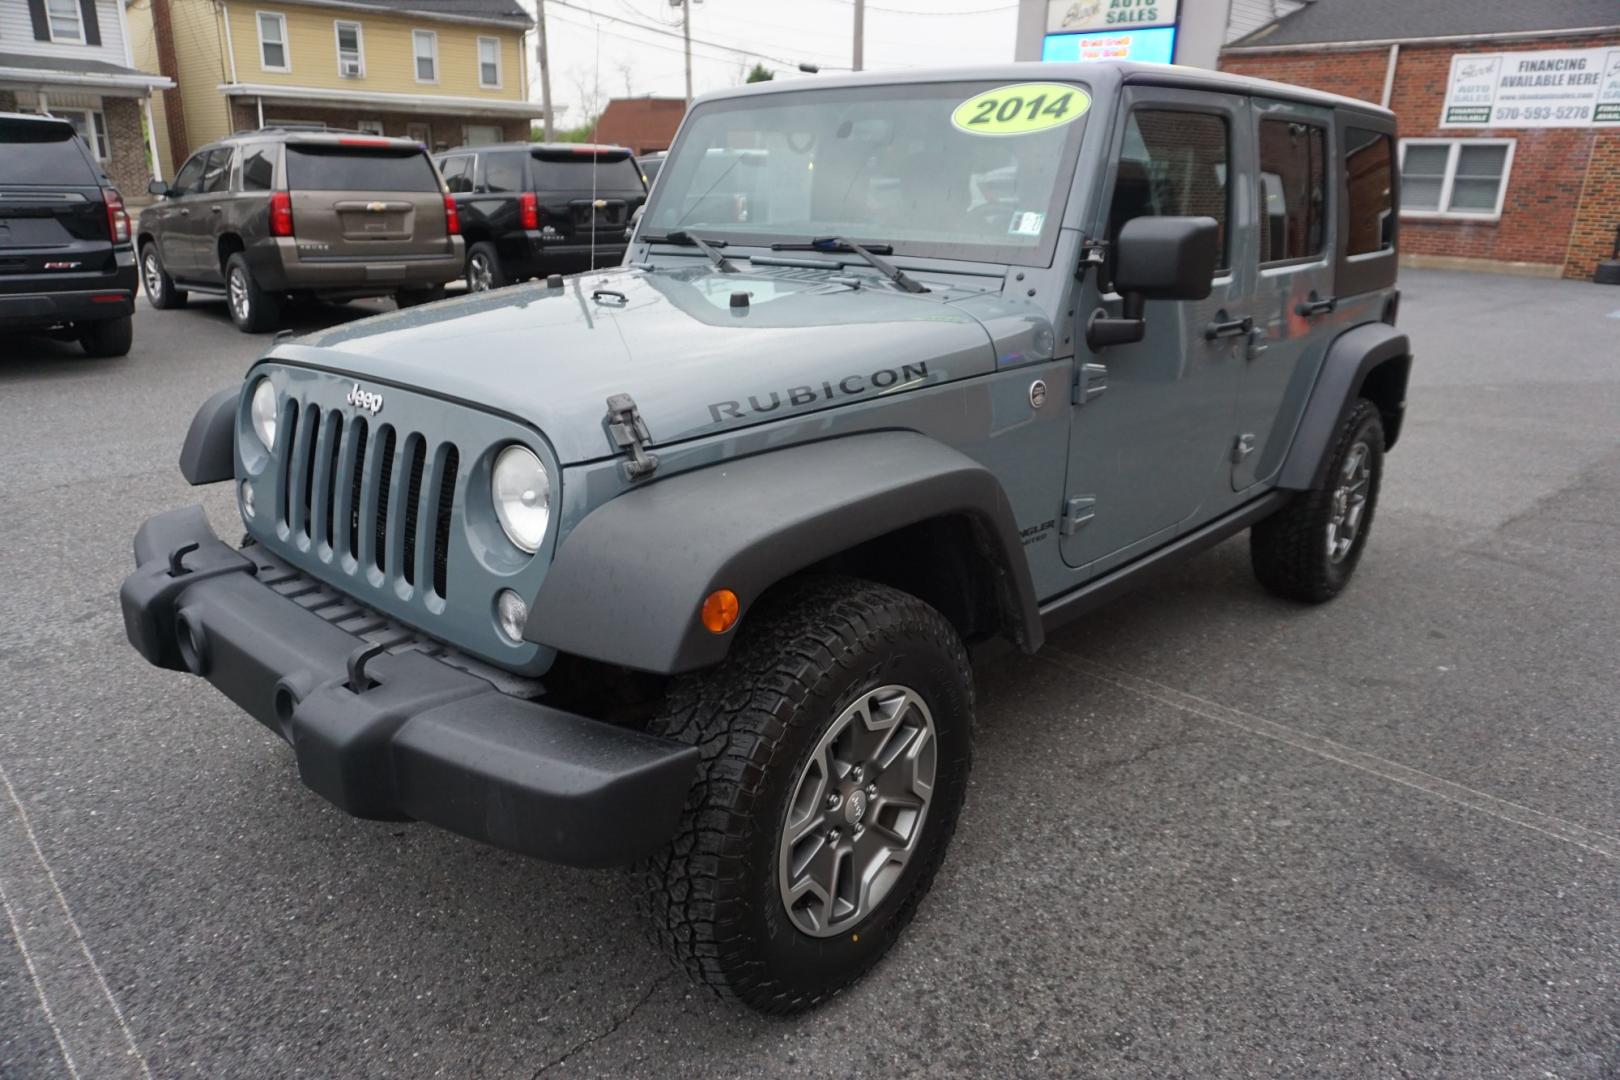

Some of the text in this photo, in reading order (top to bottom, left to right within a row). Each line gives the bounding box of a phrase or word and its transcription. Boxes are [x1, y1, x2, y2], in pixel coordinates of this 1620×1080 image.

[1106, 8, 1158, 24] SALES
[1518, 58, 1587, 72] FINANCING
[1500, 74, 1565, 88] AVAILABLE
[1567, 72, 1600, 86] HERE
[967, 92, 1074, 125] 2014
[1496, 106, 1590, 120] 570-593-5278
[347, 383, 383, 416] Jeep
[708, 361, 928, 423] RUBICON
